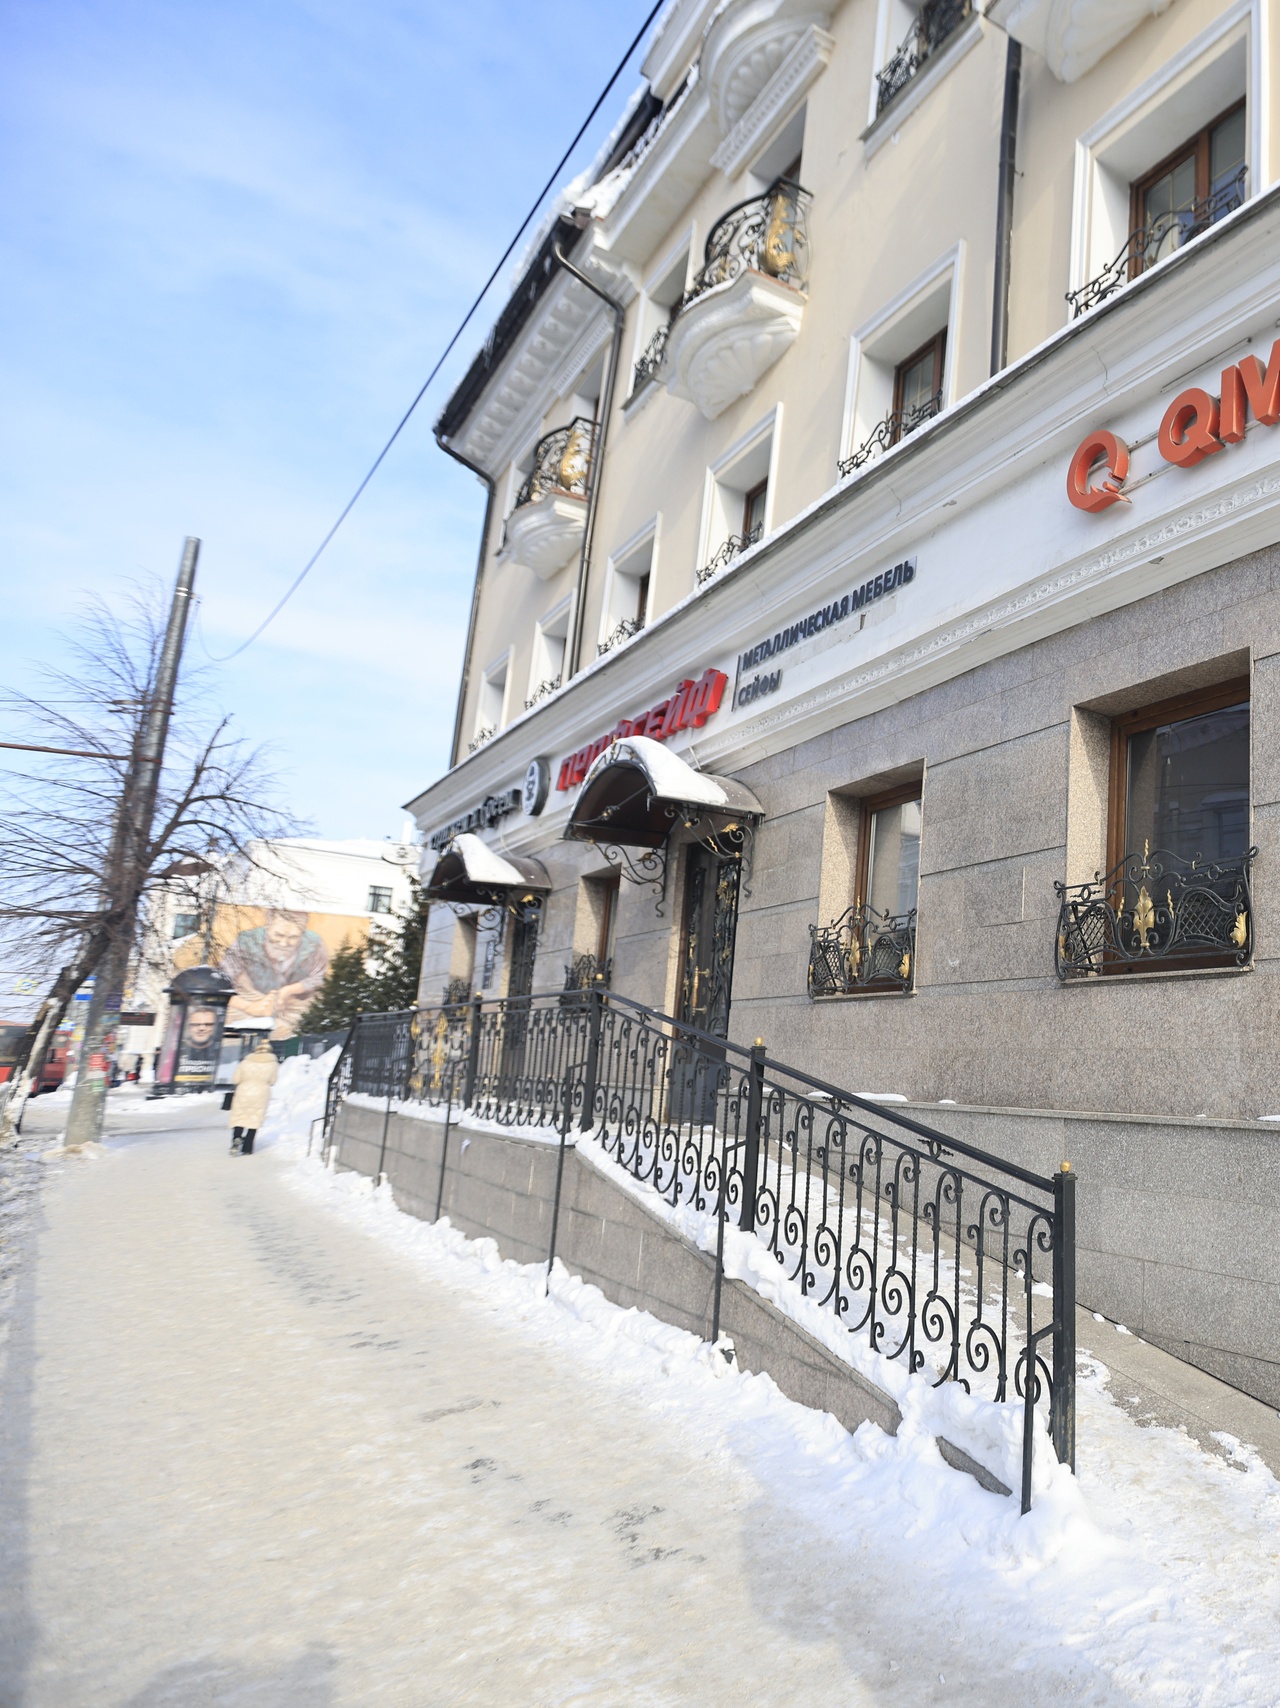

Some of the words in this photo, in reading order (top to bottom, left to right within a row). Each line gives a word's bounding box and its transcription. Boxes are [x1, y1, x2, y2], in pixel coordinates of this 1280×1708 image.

[742, 595, 849, 671] МЕТАЛЛИЧЕСКАЯ
[852, 561, 914, 611] МЕБЕЛЬ
[737, 669, 781, 706] СЕЙФЫ
